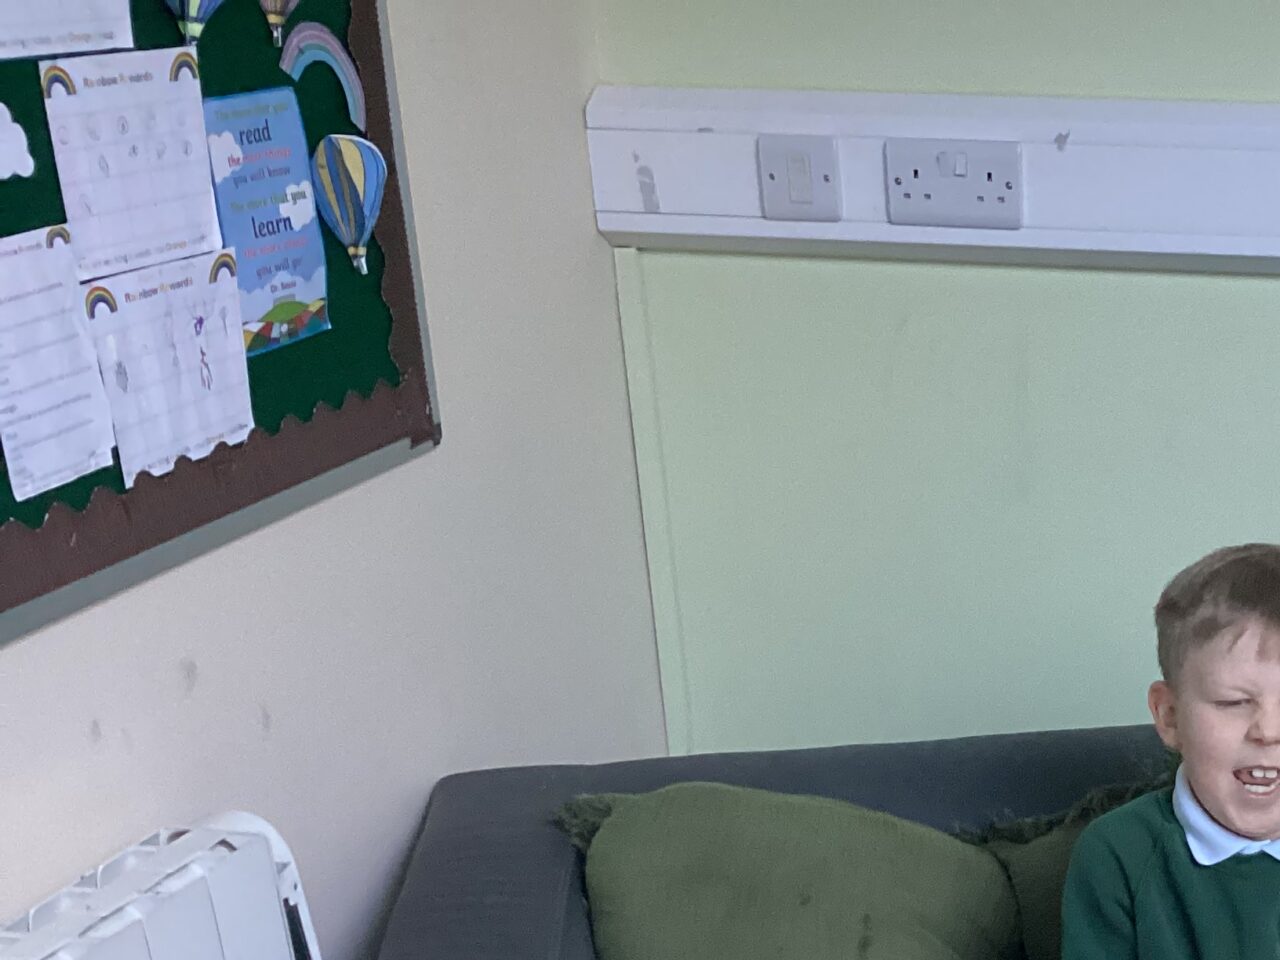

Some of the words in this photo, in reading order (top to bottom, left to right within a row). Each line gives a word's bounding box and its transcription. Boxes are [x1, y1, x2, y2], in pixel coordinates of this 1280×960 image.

[239, 118, 272, 146] read
[291, 190, 307, 206] you
[251, 215, 294, 239] learn
